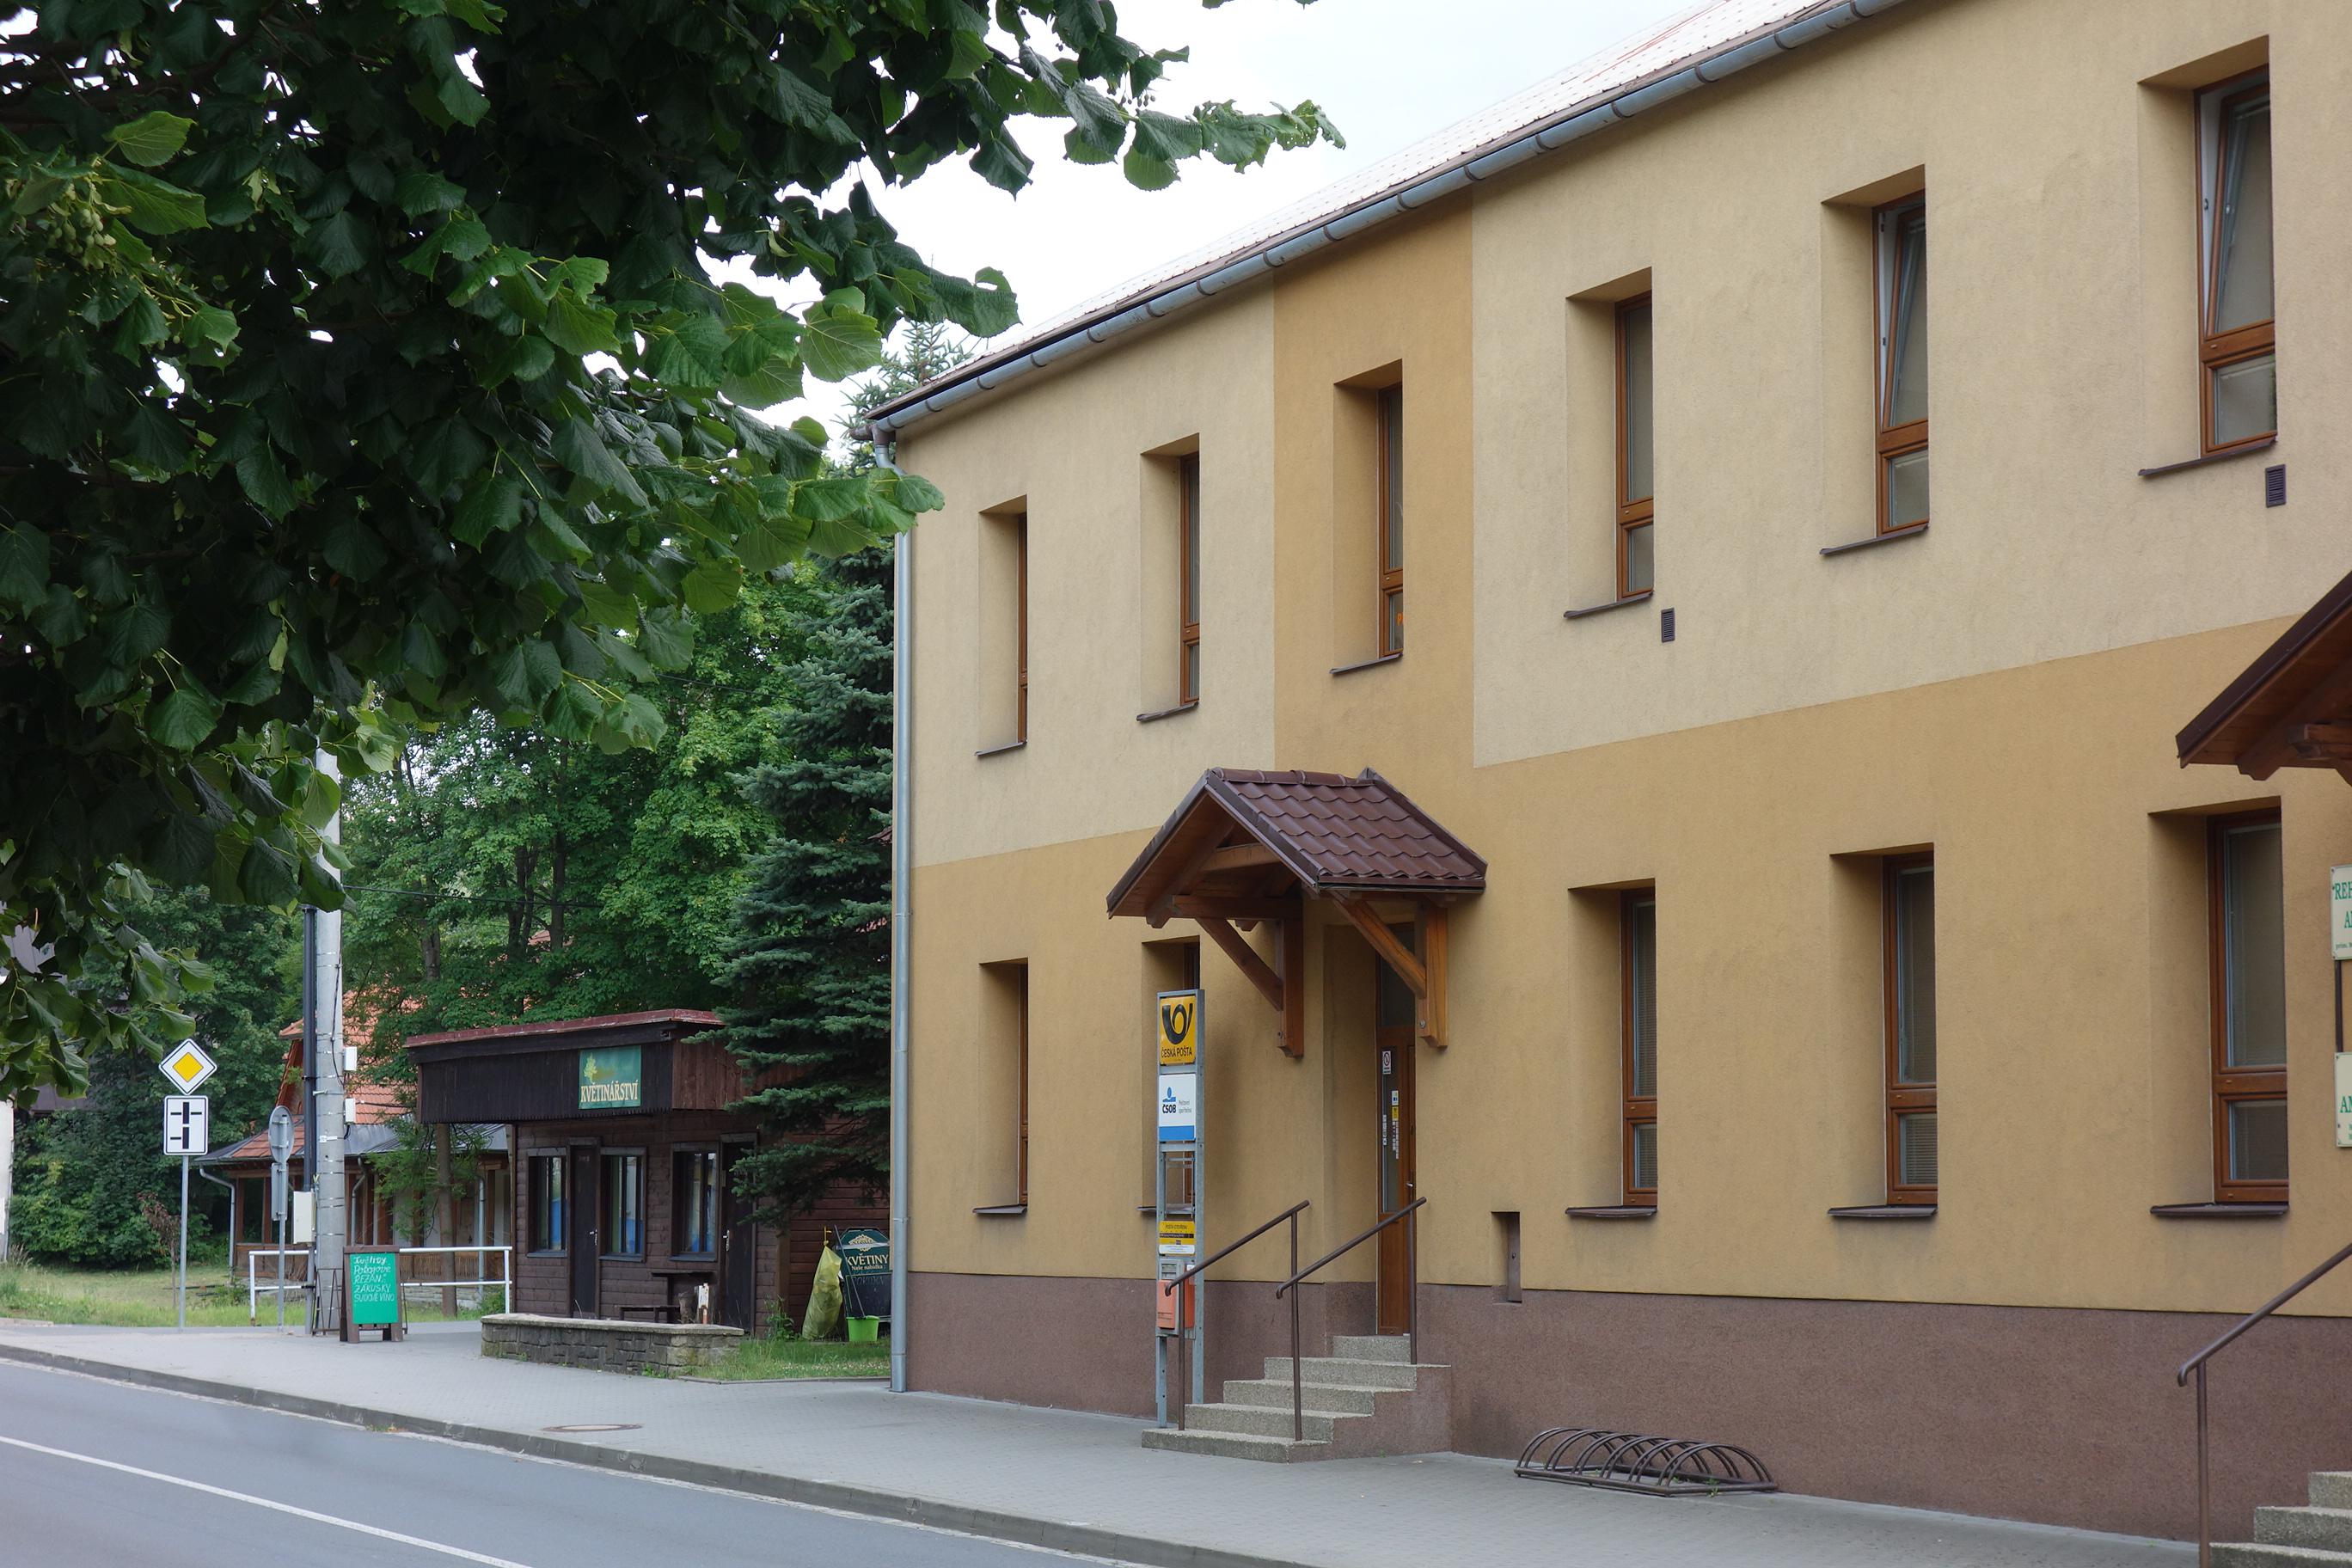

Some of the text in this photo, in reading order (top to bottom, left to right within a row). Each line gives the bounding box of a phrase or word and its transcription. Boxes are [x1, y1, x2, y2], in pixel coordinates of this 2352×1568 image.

[1161, 1045, 1192, 1058] ČESKÁ POŠTA
[580, 1079, 639, 1103] KVĚTINÁŘSTVÍ
[1162, 1104, 1176, 1113] ČSOB
[846, 1253, 888, 1265] KVĚTINY
